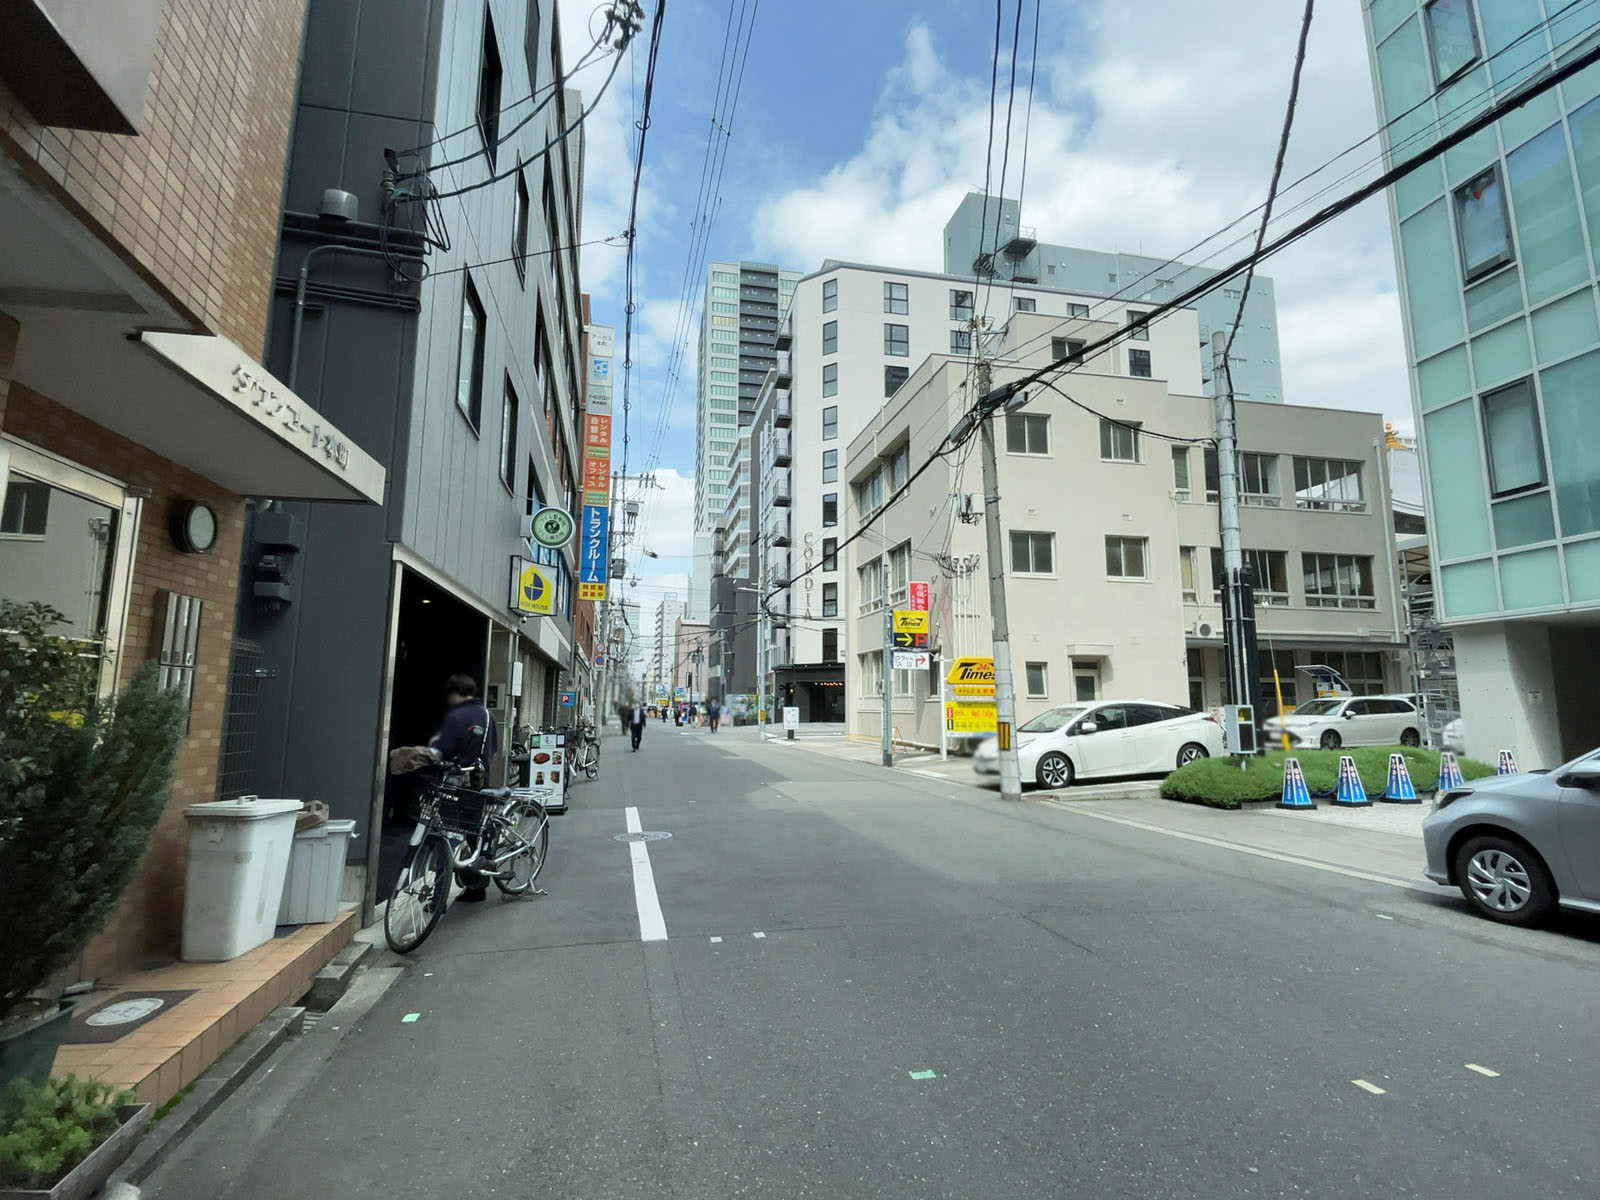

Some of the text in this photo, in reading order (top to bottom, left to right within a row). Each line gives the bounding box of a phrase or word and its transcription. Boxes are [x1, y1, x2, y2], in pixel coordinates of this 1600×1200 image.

[600, 417, 608, 443] レンタル
[588, 461, 597, 487] オフィス
[597, 461, 606, 488] レンタル
[587, 507, 601, 582] トランクルーム
[803, 532, 814, 622] CORDIA
[900, 617, 923, 627] Times
[915, 633, 927, 646] P
